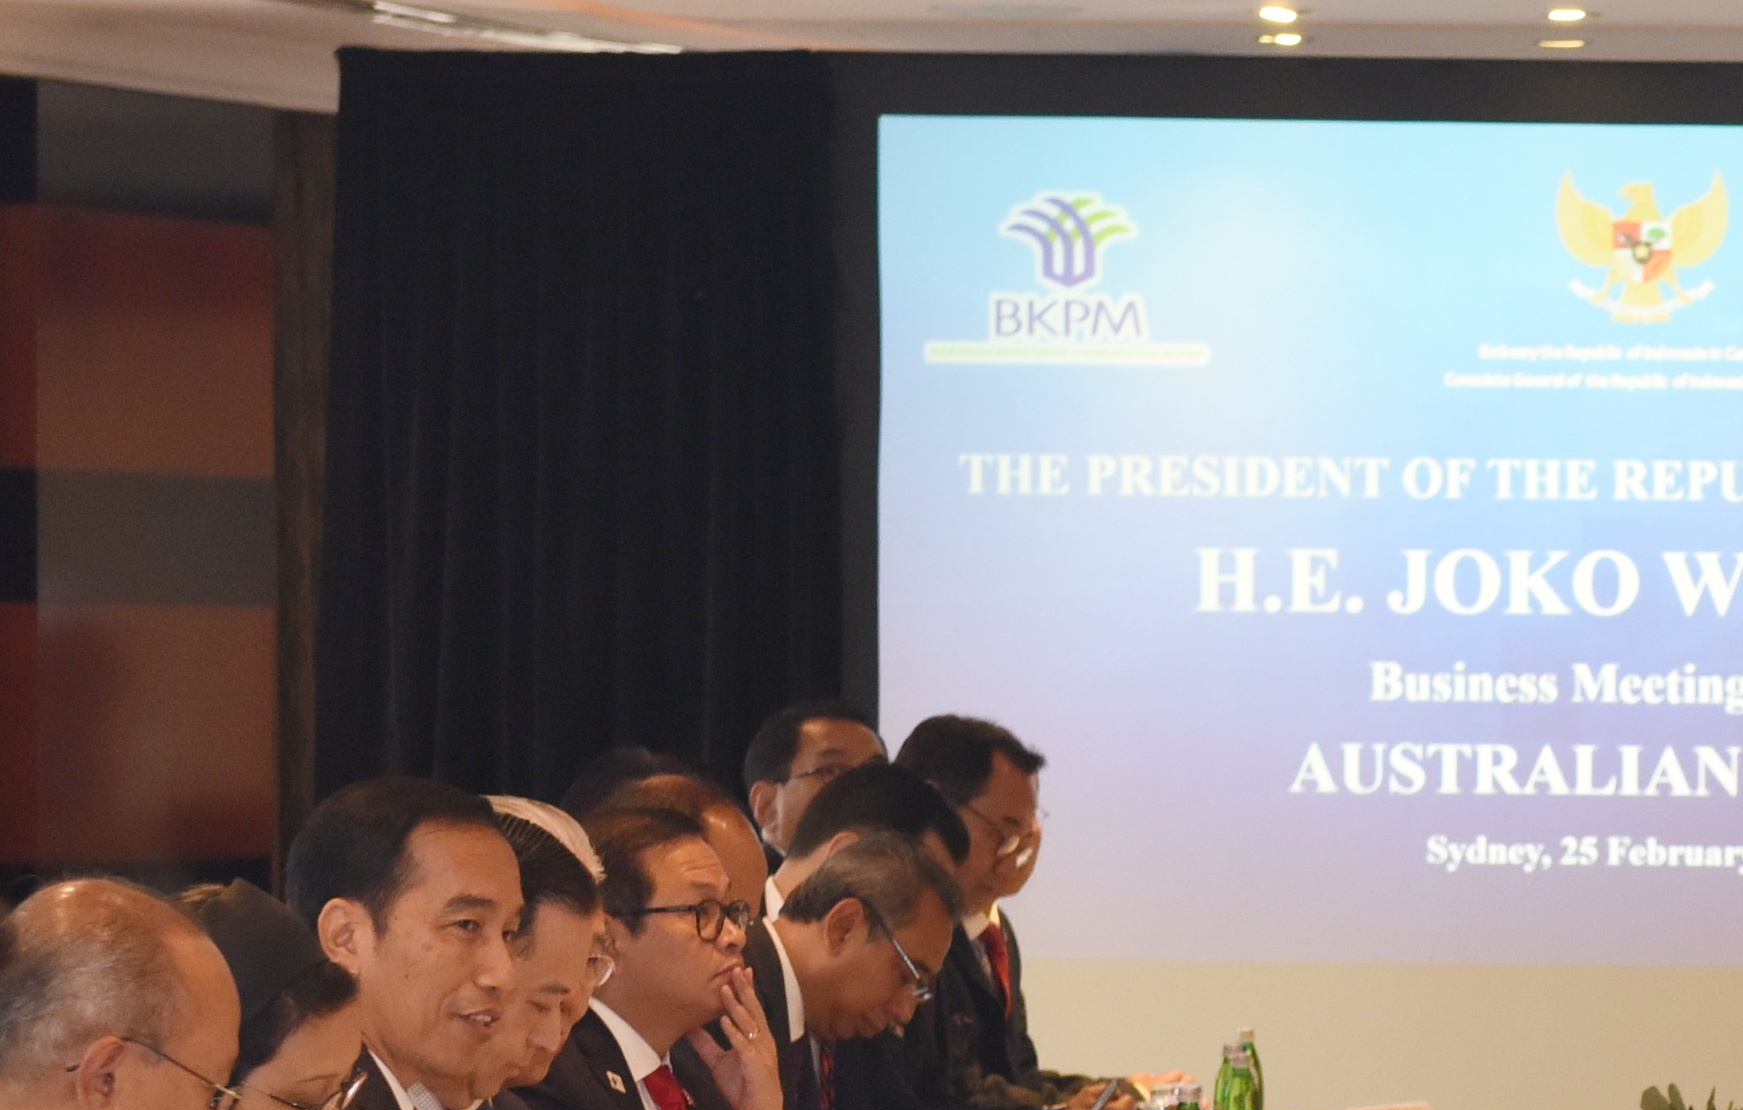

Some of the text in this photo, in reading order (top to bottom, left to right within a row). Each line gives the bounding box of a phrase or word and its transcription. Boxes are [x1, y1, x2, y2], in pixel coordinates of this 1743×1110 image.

[994, 298, 1142, 337] BKPM
[961, 455, 1069, 493] THE
[1086, 456, 1389, 498] PRESIDENT
[1403, 458, 1477, 499] OF
[1490, 459, 1598, 501] THE
[1196, 548, 1365, 615] H.E.
[1387, 549, 1641, 618] JOKO
[1370, 661, 1560, 704] Business
[1290, 743, 1743, 799] AUSTRALIAN
[1426, 835, 1554, 874] Sydney,
[1560, 836, 1600, 867] 25
